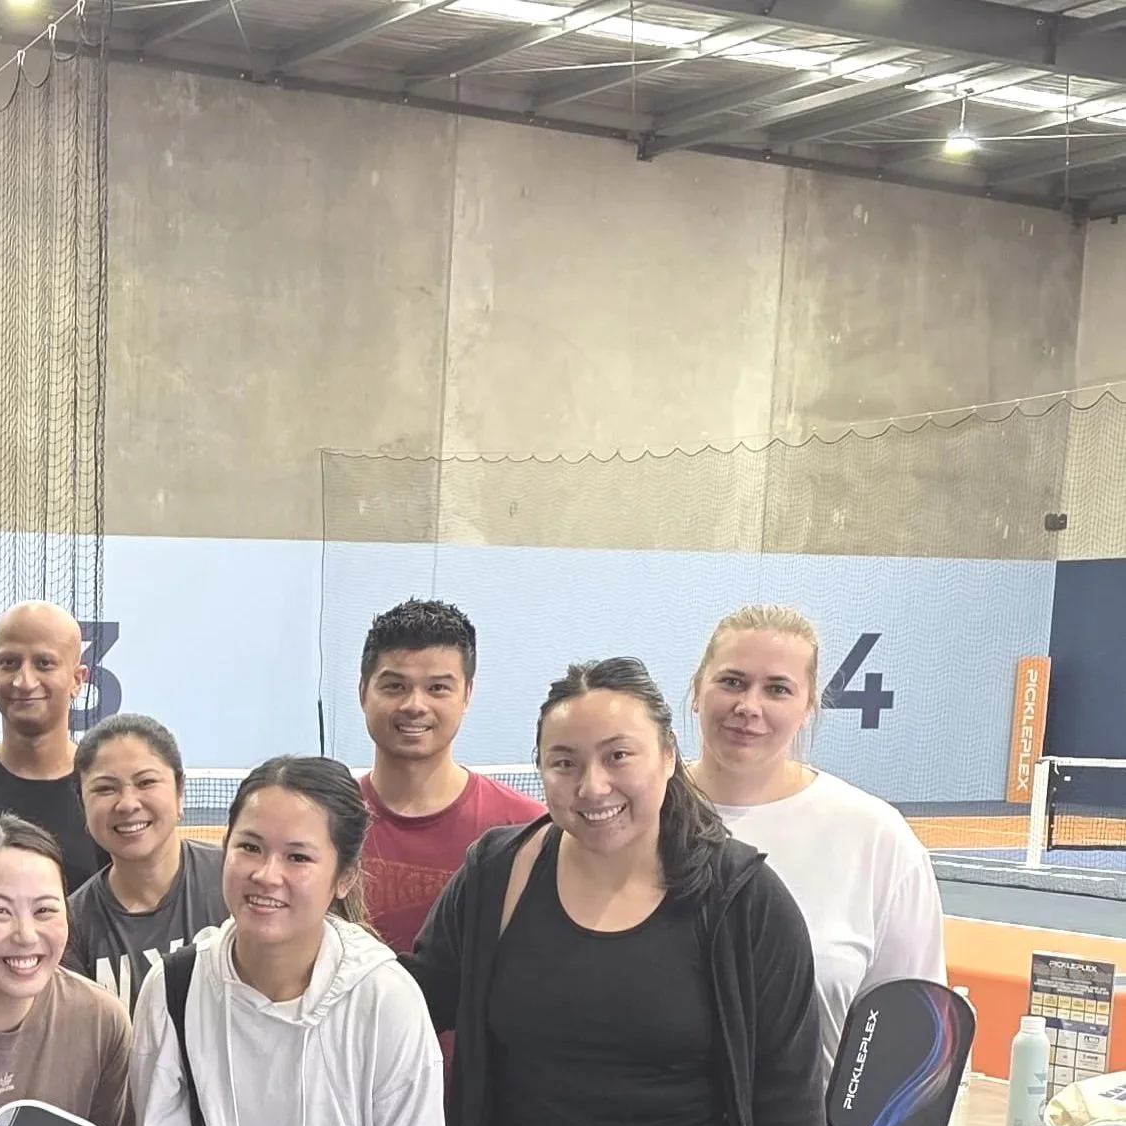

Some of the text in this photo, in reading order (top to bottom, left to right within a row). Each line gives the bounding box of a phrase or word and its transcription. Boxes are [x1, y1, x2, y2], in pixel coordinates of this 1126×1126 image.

[68, 621, 122, 731] 3
[821, 632, 894, 729] 4
[1016, 668, 1038, 791] PICKLEPLEX
[843, 1009, 879, 1109] PICKLEPLEX
